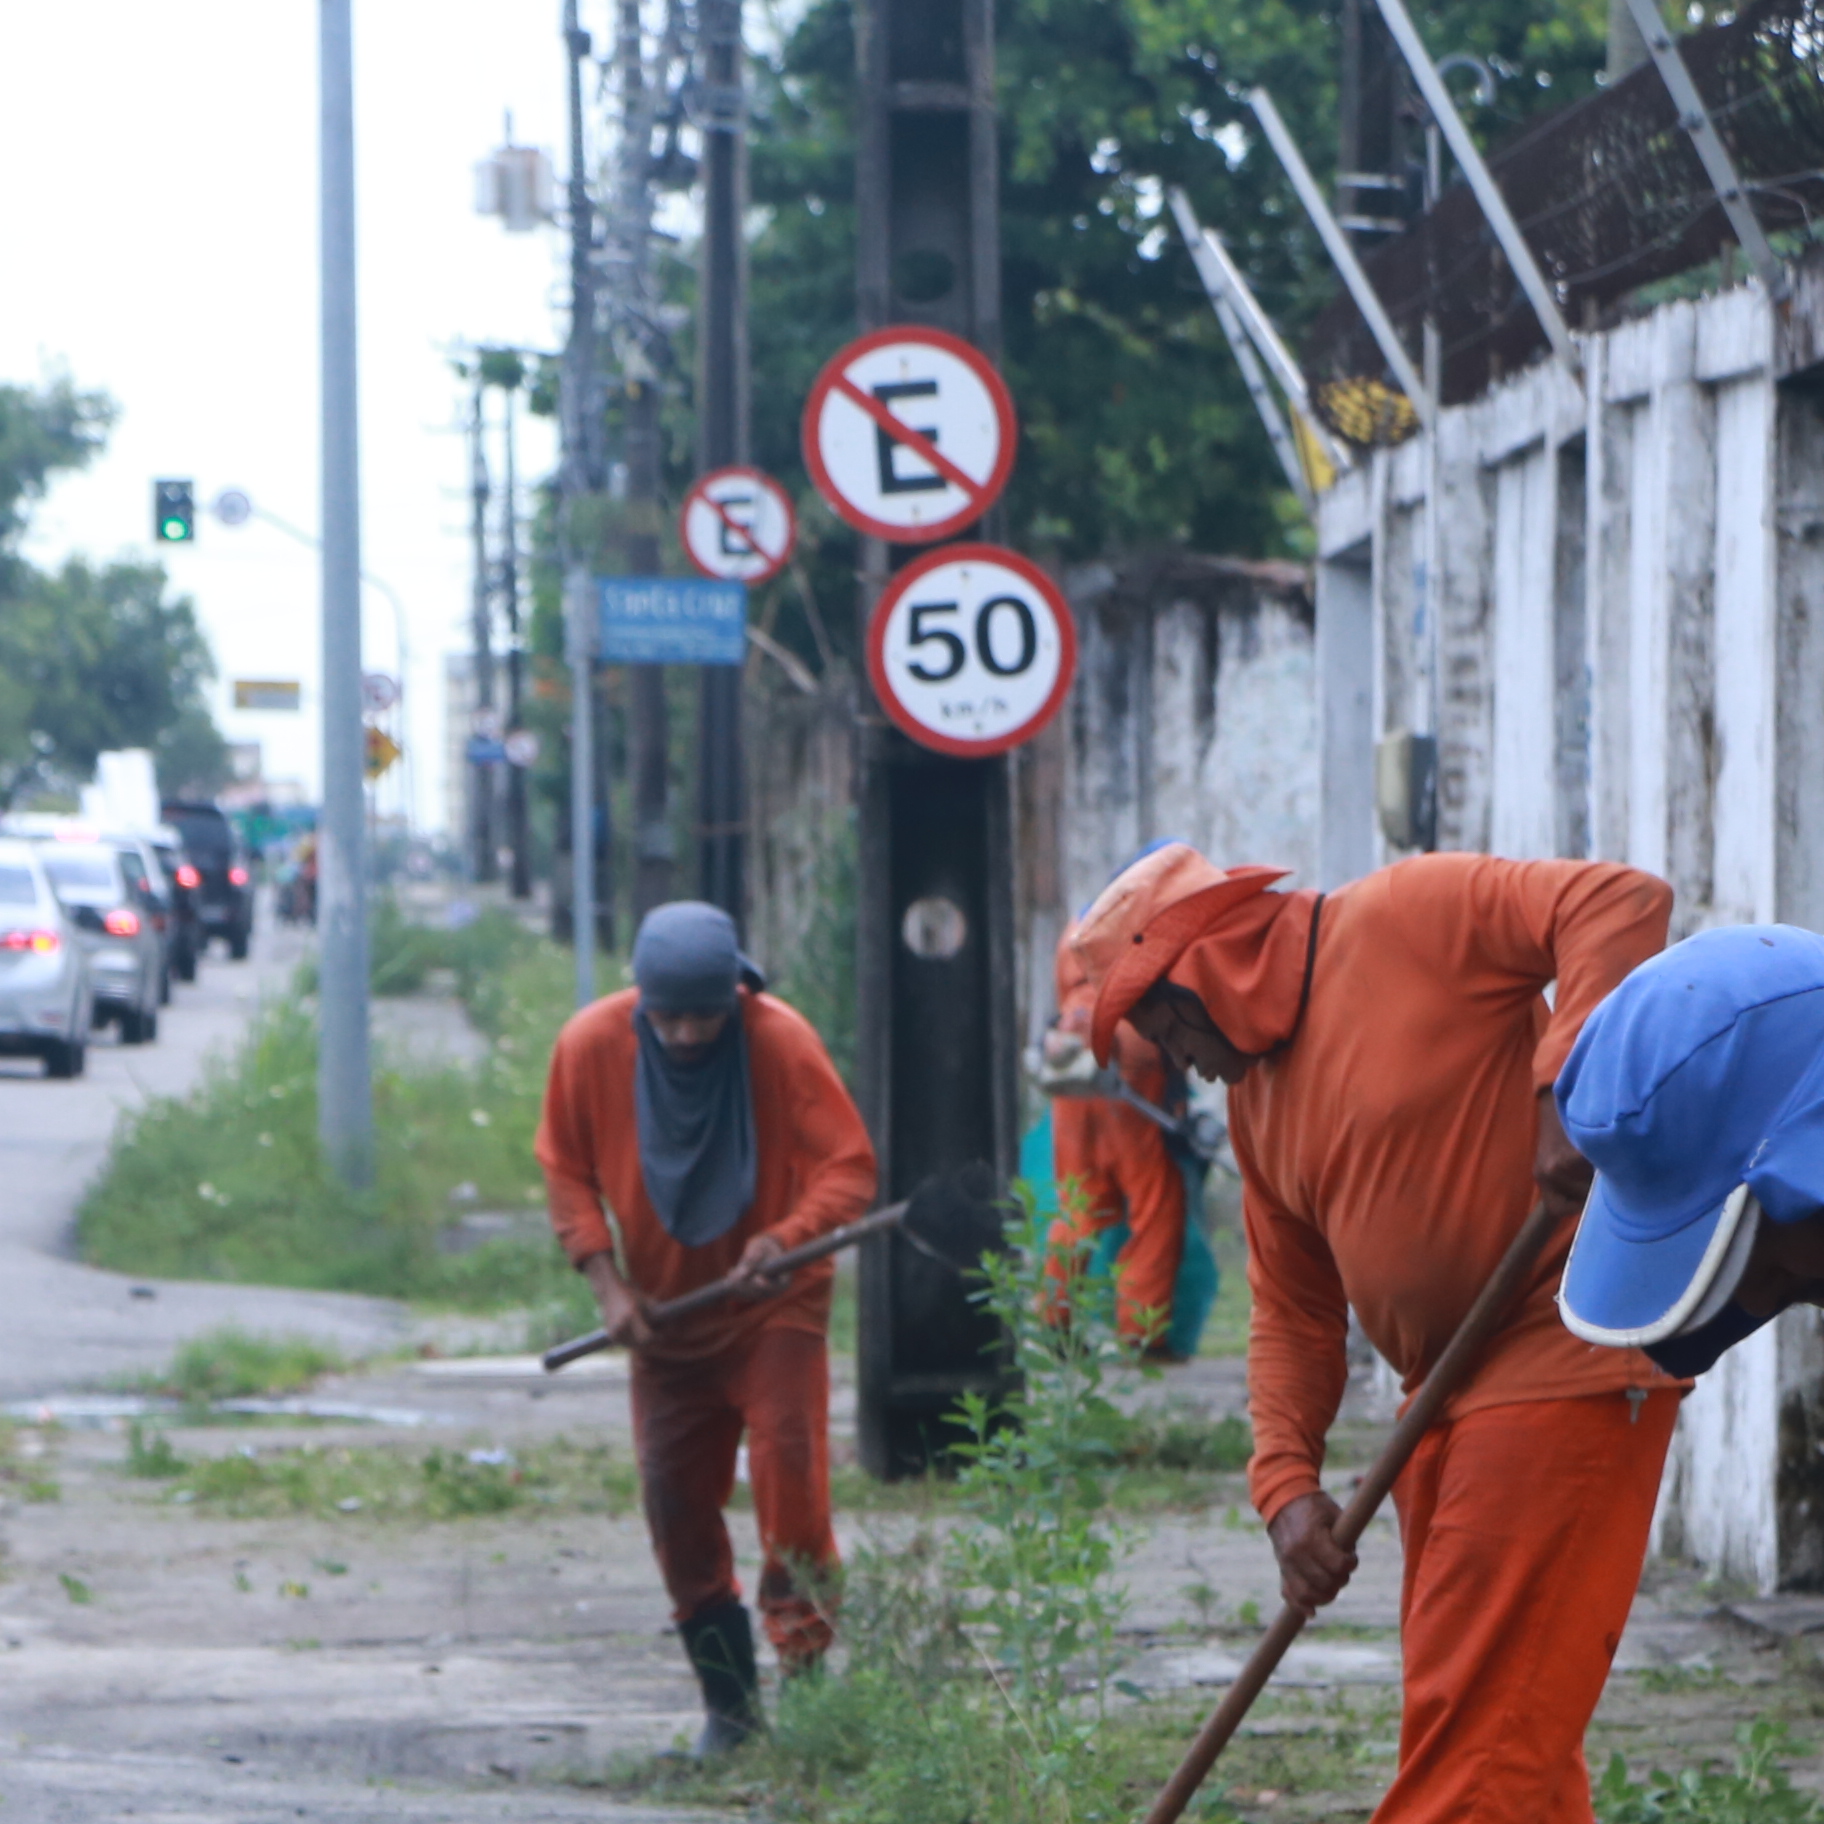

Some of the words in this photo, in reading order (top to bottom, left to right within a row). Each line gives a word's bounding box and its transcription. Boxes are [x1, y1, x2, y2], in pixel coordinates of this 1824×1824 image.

[873, 380, 947, 493] E
[720, 497, 754, 556] E
[908, 596, 1037, 682] 50
